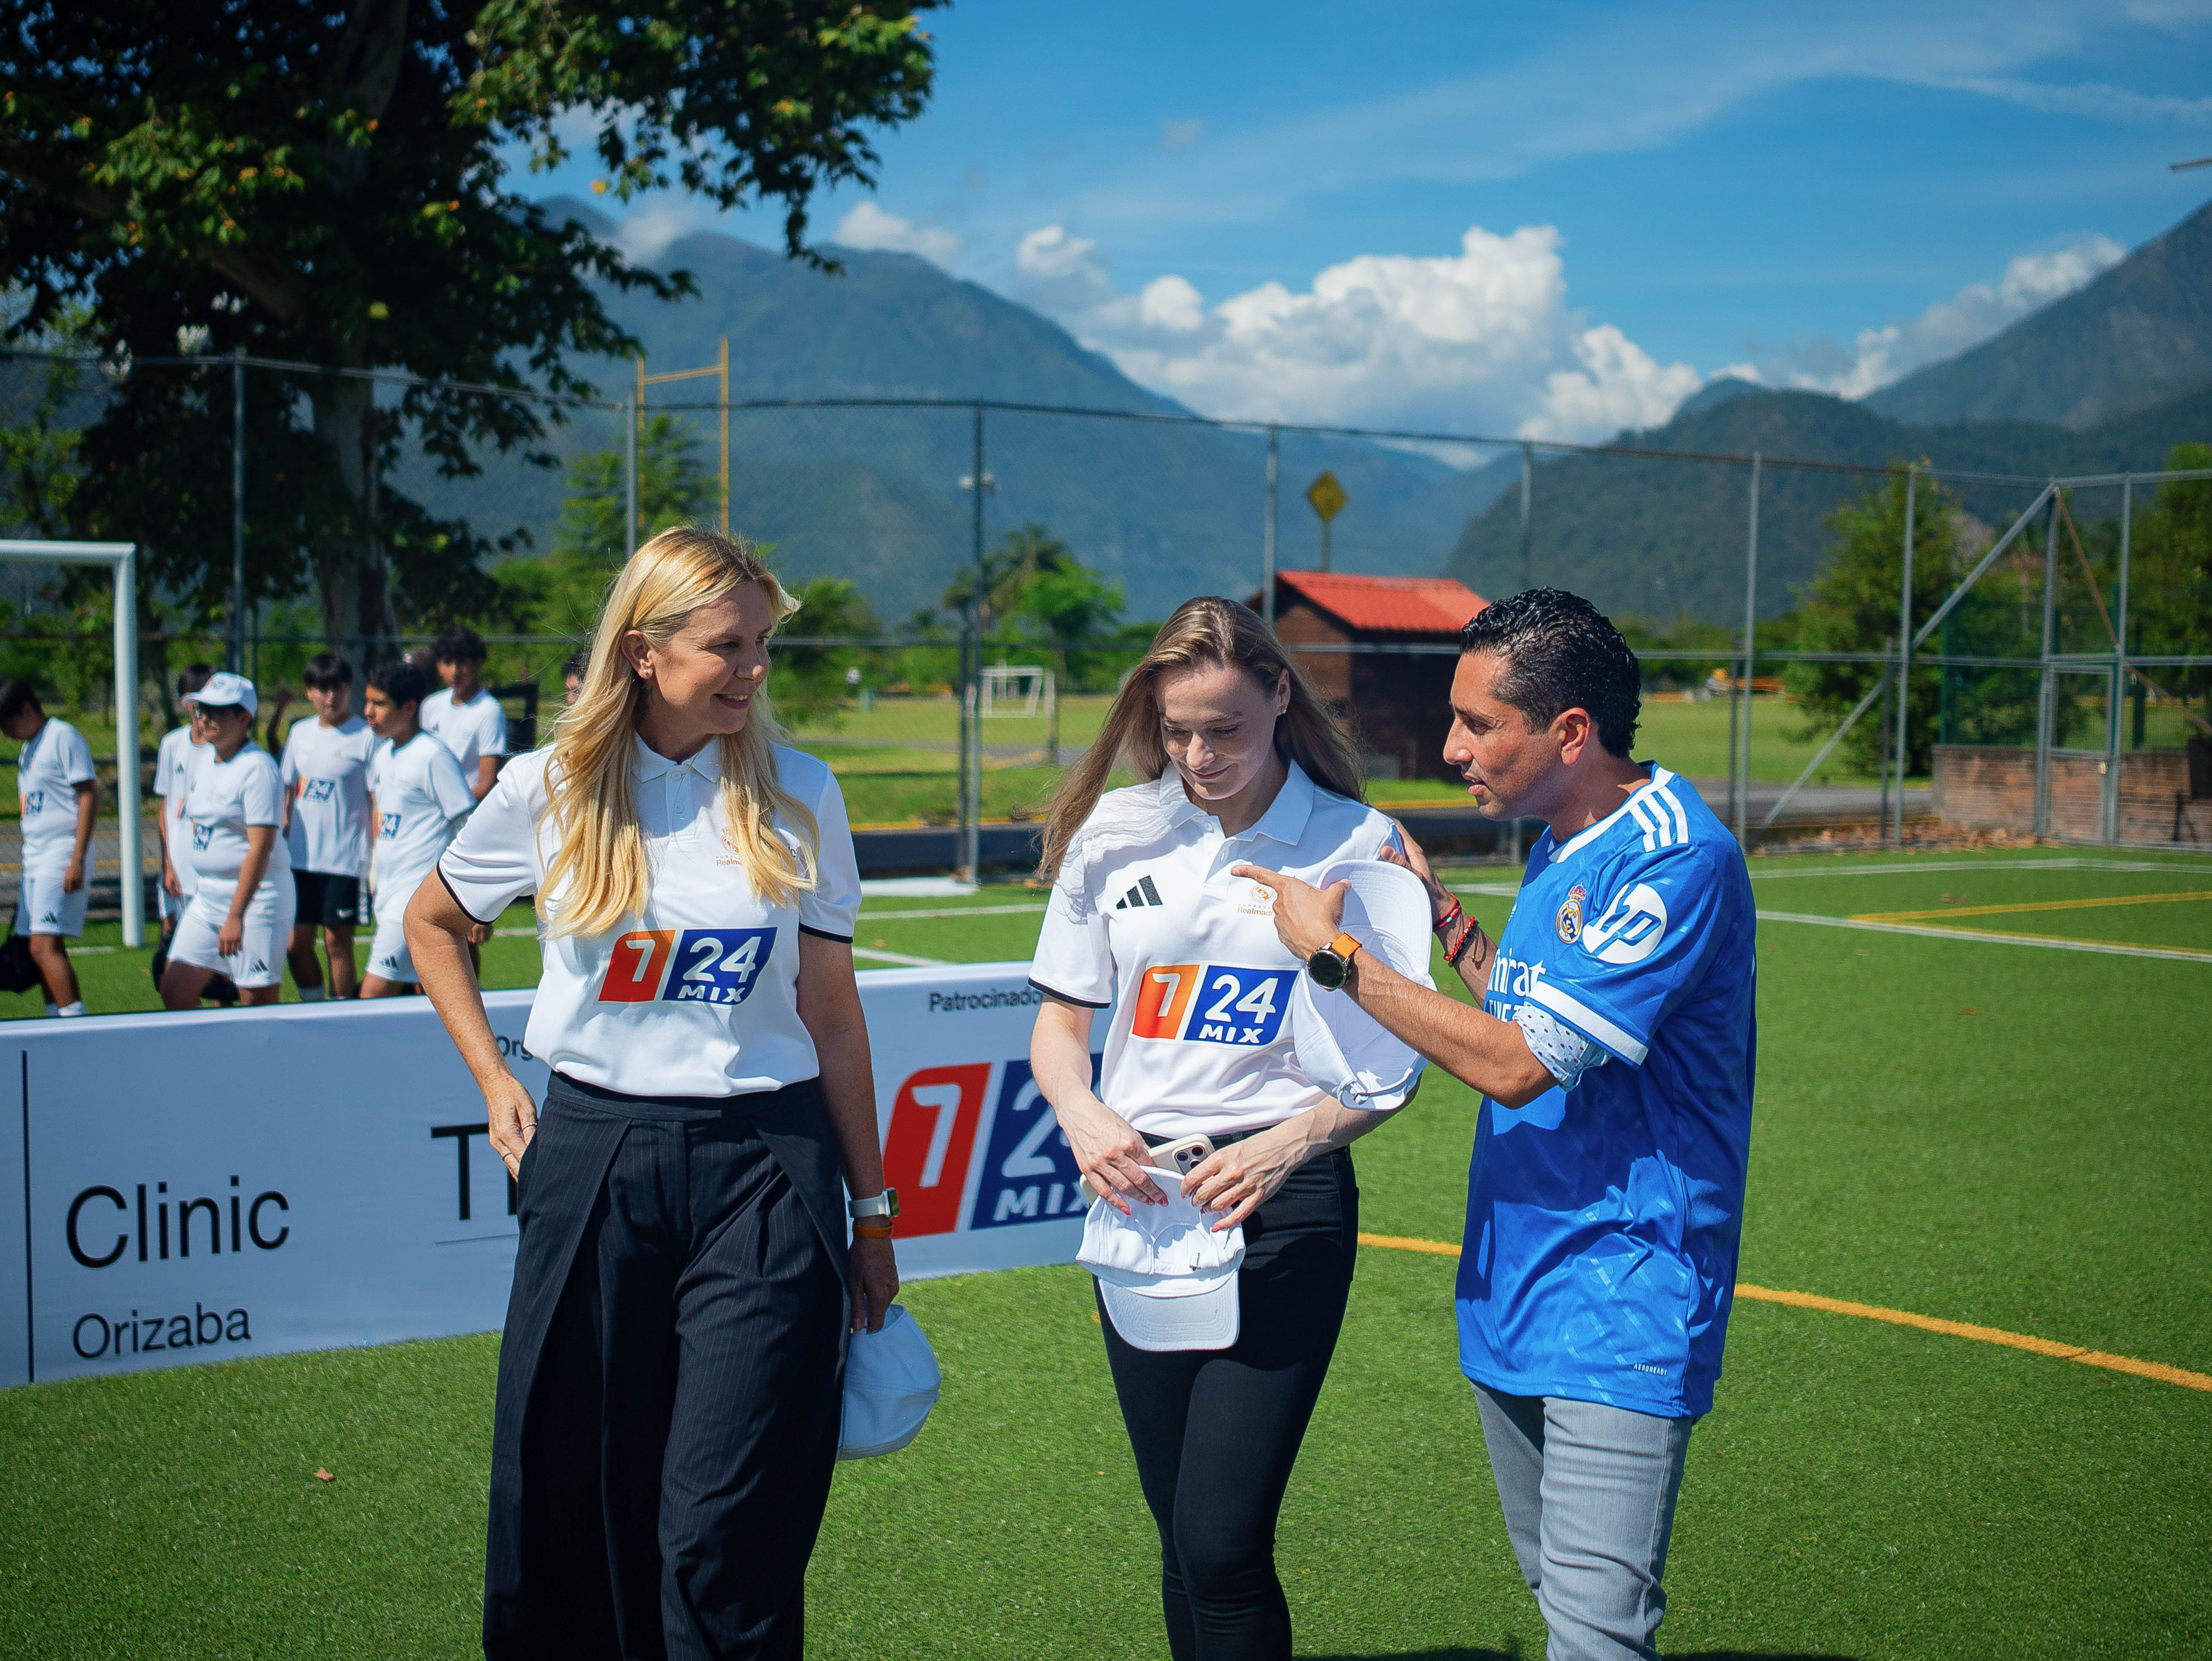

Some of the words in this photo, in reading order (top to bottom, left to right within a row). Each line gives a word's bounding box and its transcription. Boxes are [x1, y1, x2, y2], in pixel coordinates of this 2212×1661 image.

[682, 936, 762, 984] 24
[677, 985, 746, 1002] MIX
[1204, 974, 1279, 1024] 24
[1198, 1024, 1264, 1044] MIX
[66, 1175, 290, 1268] Clinic
[73, 1302, 251, 1359] Orizaba
[1633, 1363, 1668, 1376] AEROREADY
